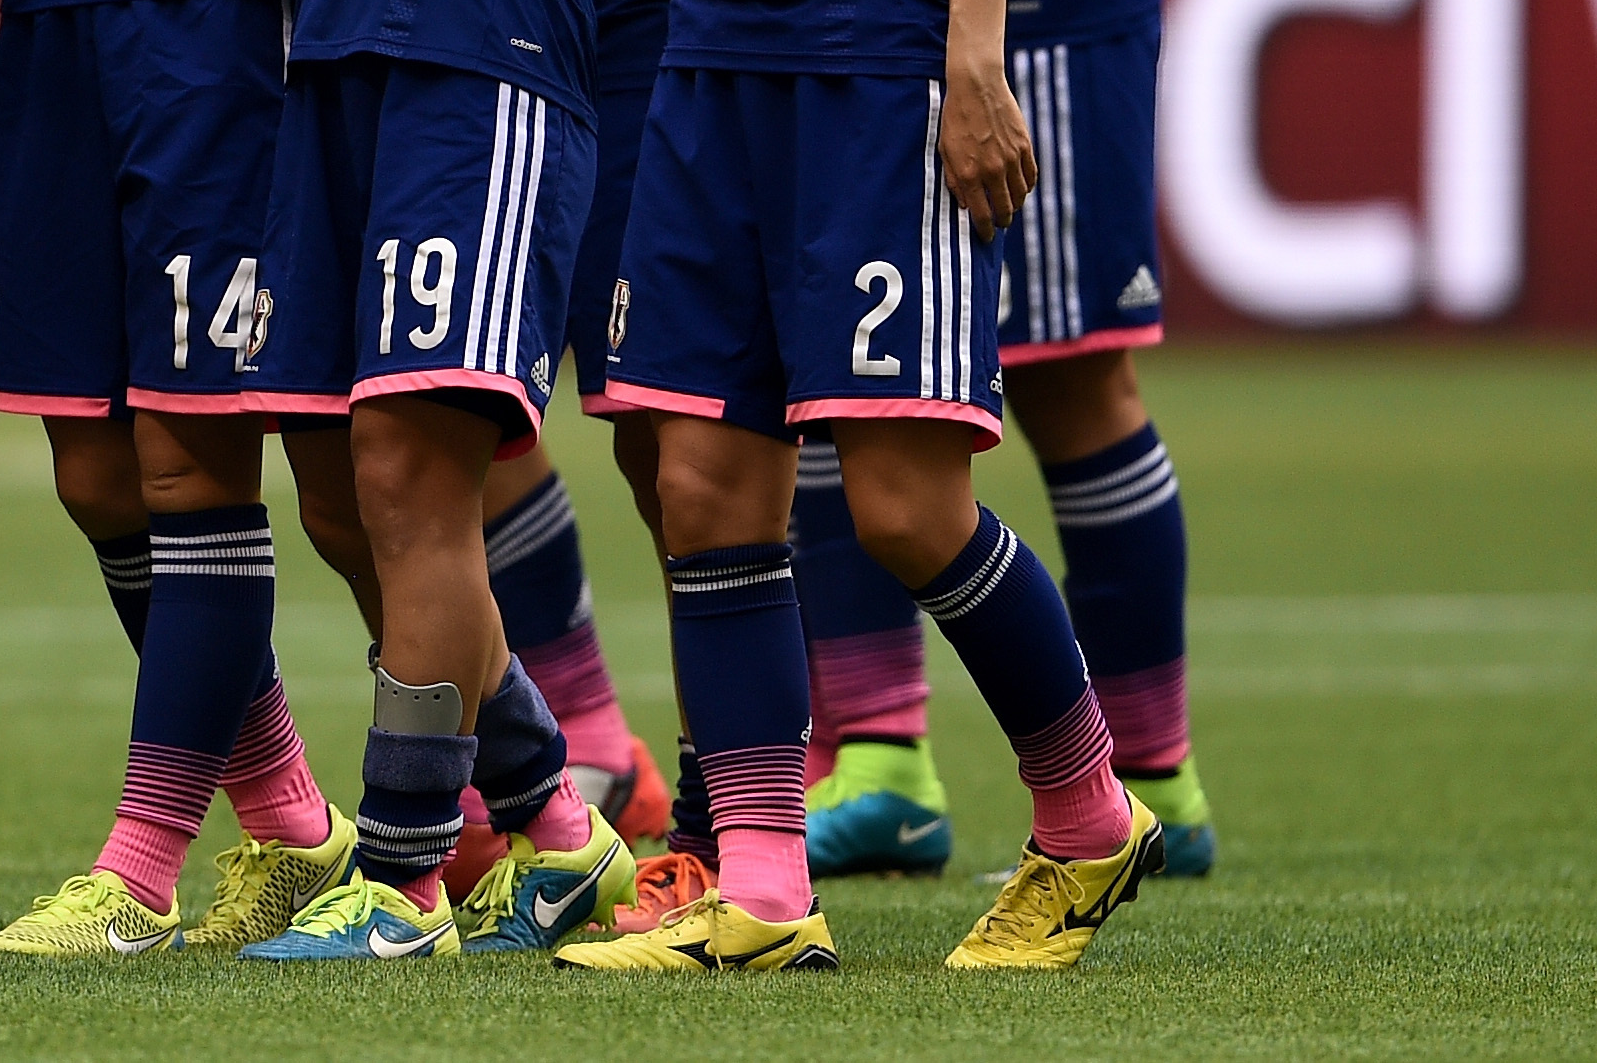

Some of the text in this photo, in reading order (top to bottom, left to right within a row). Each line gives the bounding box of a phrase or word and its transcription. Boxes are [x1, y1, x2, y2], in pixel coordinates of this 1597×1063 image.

[510, 38, 542, 53] adizero
[164, 255, 257, 373] 14
[376, 238, 458, 355] 19
[851, 260, 903, 376] 2
